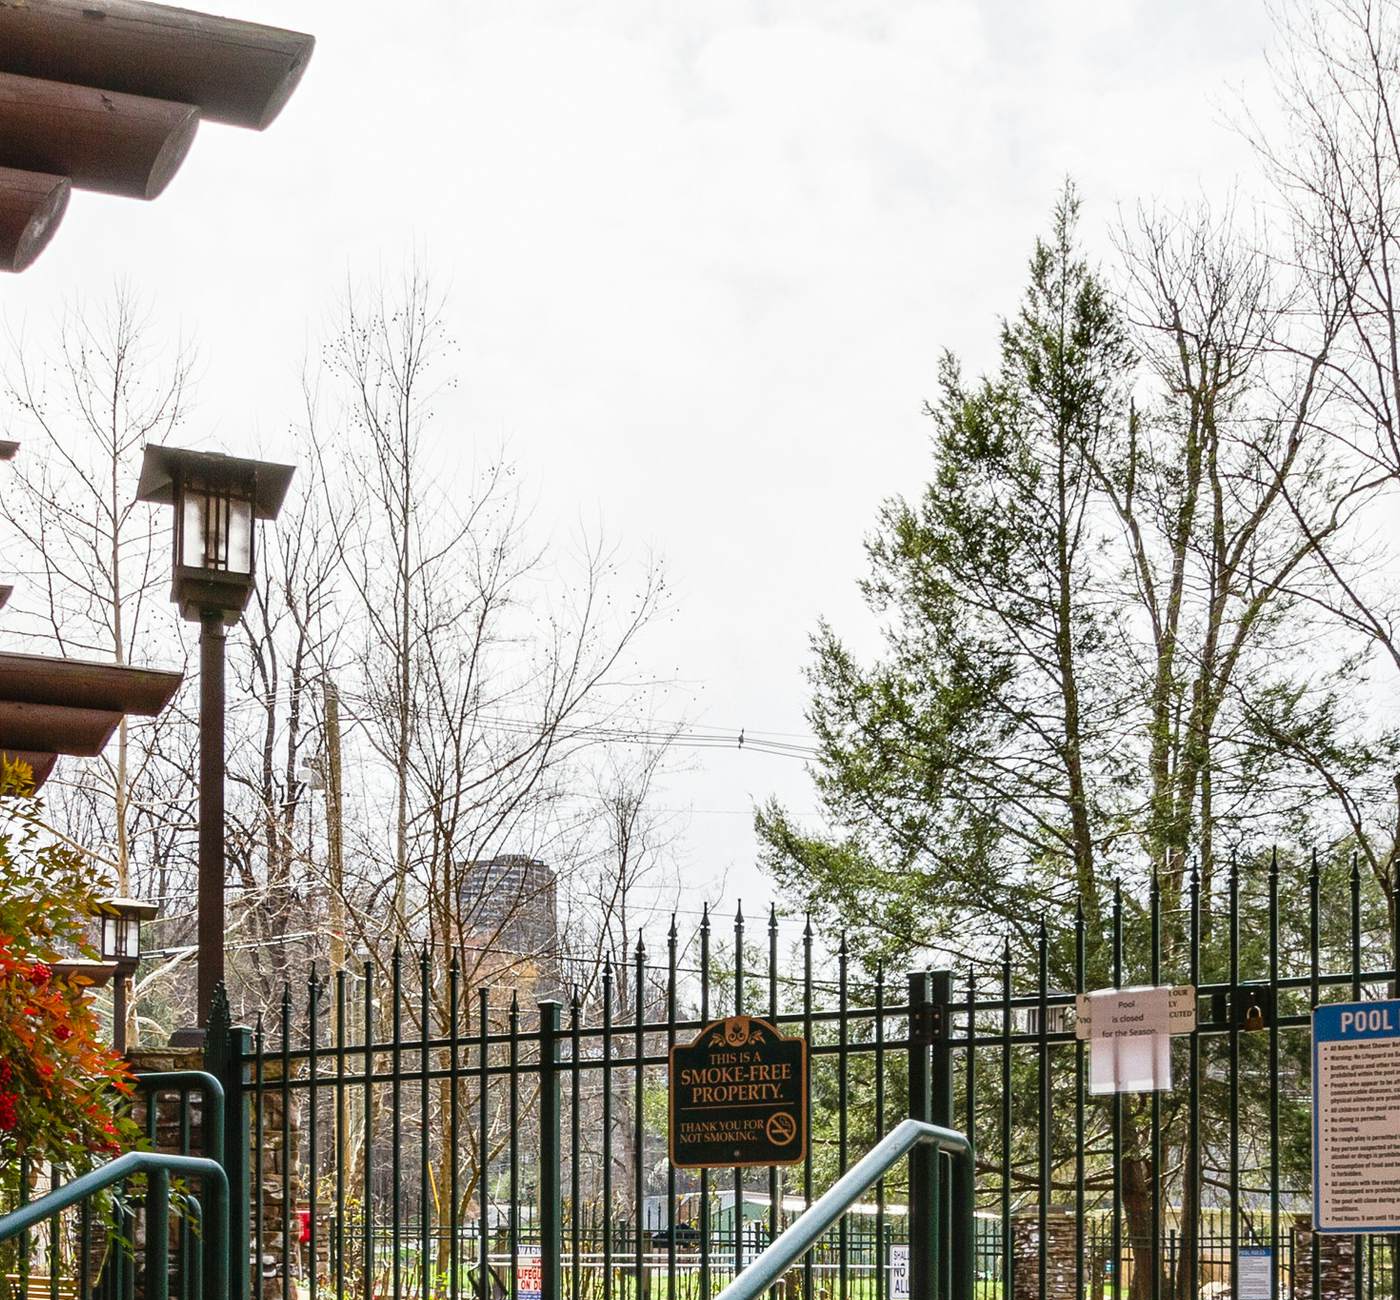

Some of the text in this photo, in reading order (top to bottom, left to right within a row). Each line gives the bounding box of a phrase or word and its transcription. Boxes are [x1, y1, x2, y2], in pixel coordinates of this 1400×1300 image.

[1118, 1000, 1135, 1008] Pool
[1120, 1013, 1144, 1023] closed
[1341, 1009, 1393, 1033] POOL
[1102, 1028, 1158, 1038] for the Season.
[709, 1050, 761, 1065] THIS IS A
[681, 1063, 791, 1086] SMOKE-FREE
[692, 1083, 783, 1103] PROPERTY.
[680, 1119, 764, 1133] THANK YOU FOR
[680, 1130, 757, 1143] NOT SMOKING.
[894, 1263, 906, 1277] NO
